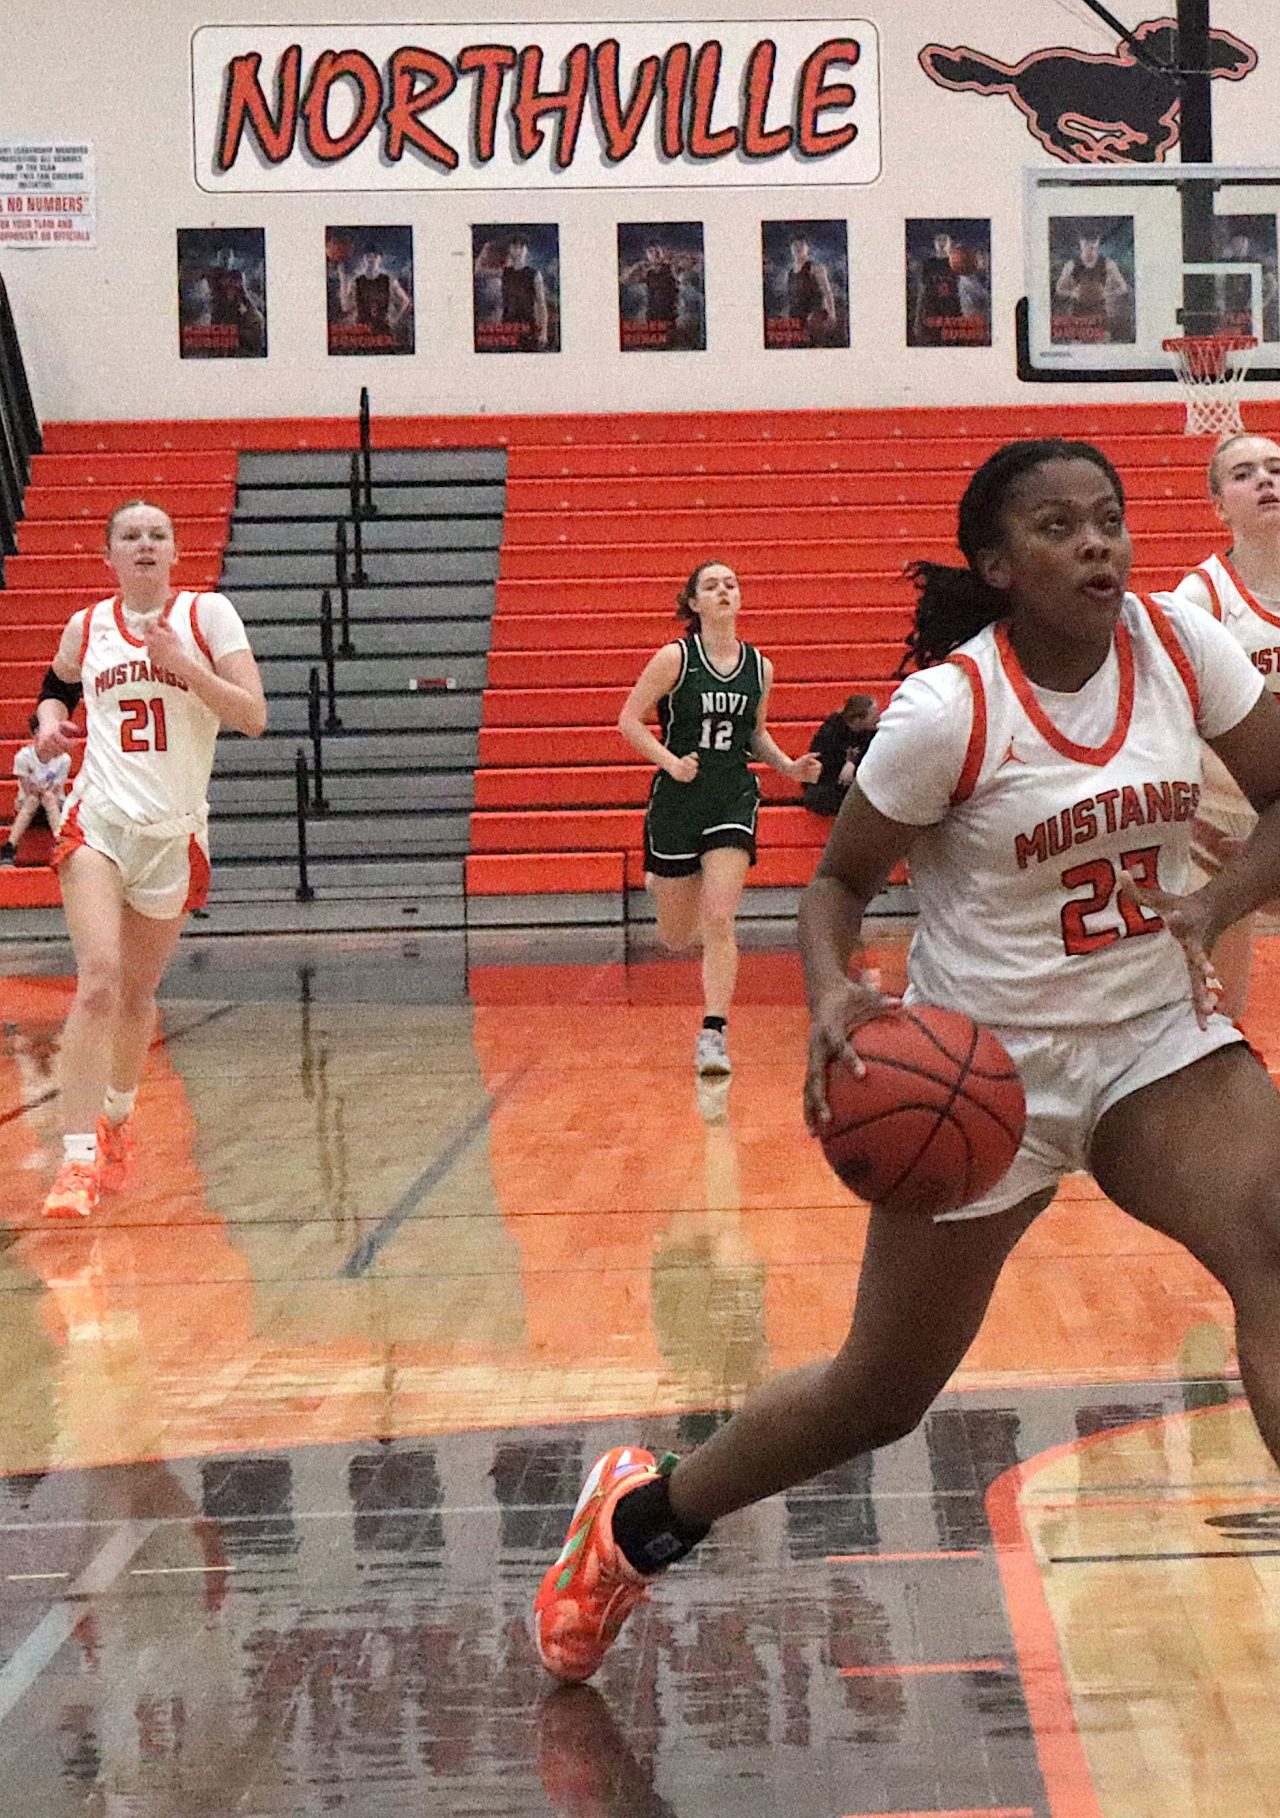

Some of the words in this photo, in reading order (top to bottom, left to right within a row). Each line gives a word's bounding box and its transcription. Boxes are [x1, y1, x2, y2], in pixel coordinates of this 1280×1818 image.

[213, 38, 862, 172] NORTHVILLE
[27, 196, 83, 212] NUMBERS
[118, 697, 167, 752] 21
[701, 692, 748, 716] NOVI
[698, 718, 734, 751] 12
[1060, 844, 1164, 957] 22
